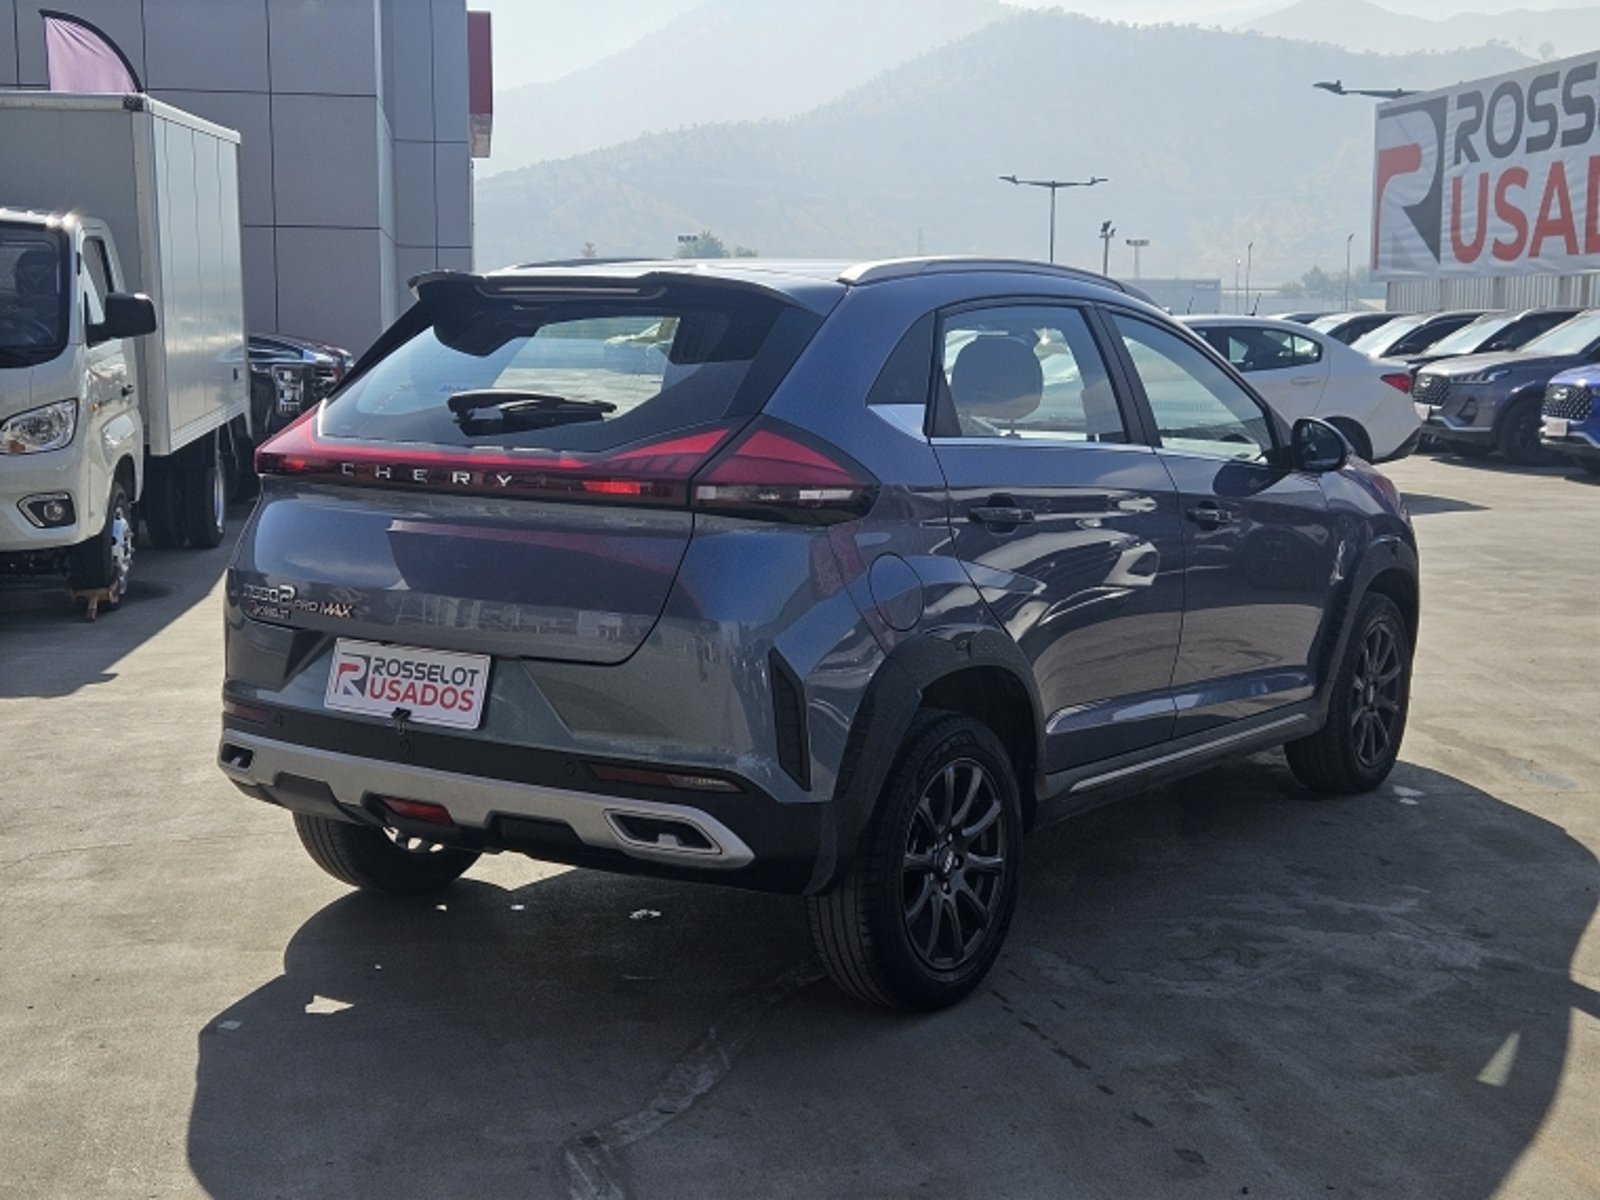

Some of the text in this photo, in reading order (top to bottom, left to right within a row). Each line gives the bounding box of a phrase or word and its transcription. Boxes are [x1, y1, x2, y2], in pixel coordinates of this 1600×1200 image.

[340, 462, 513, 487] CHERY
[320, 601, 353, 619] MAX
[372, 657, 480, 687] ROSSELOT
[369, 677, 475, 712] USADOS
